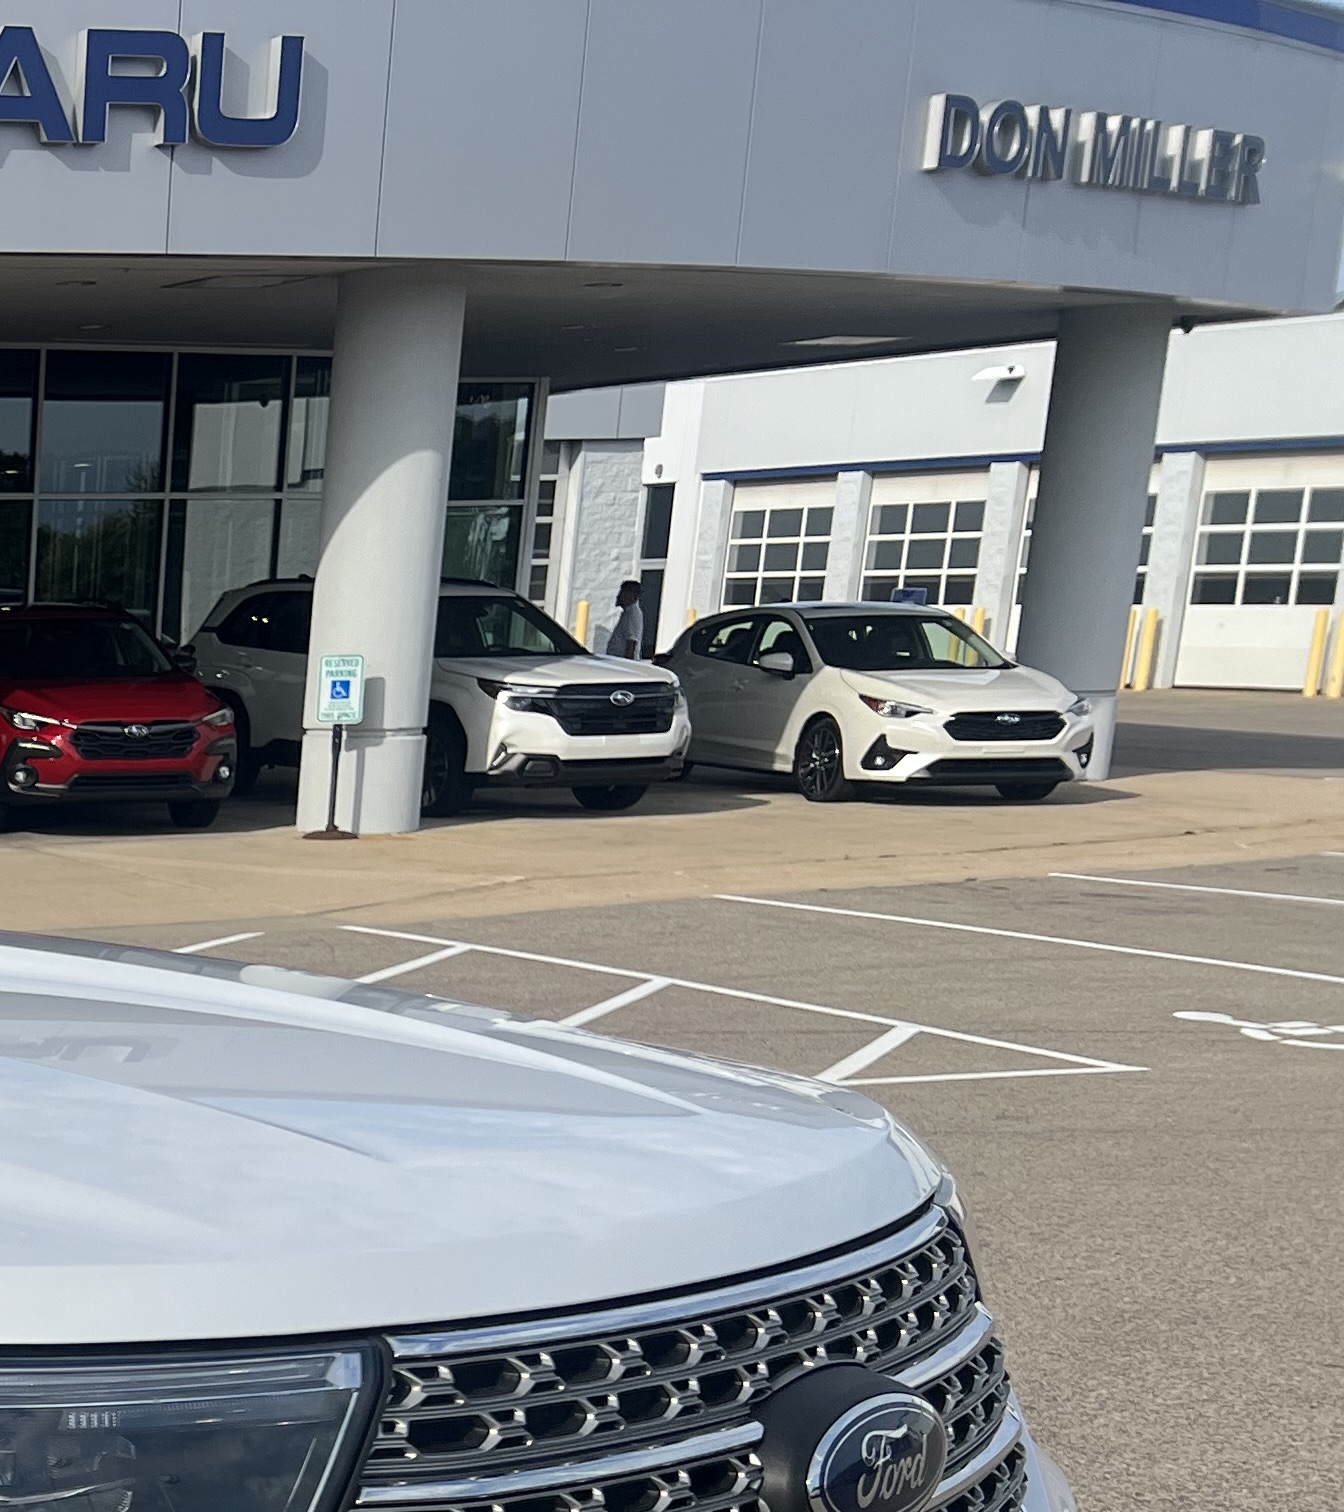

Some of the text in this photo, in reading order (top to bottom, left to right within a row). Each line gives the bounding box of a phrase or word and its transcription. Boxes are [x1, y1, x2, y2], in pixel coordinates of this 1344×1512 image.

[922, 92, 1266, 204] DON MILLER
[325, 658, 359, 668] RESERVED
[325, 669, 357, 678] PARKING
[856, 1423, 928, 1509] Ford
